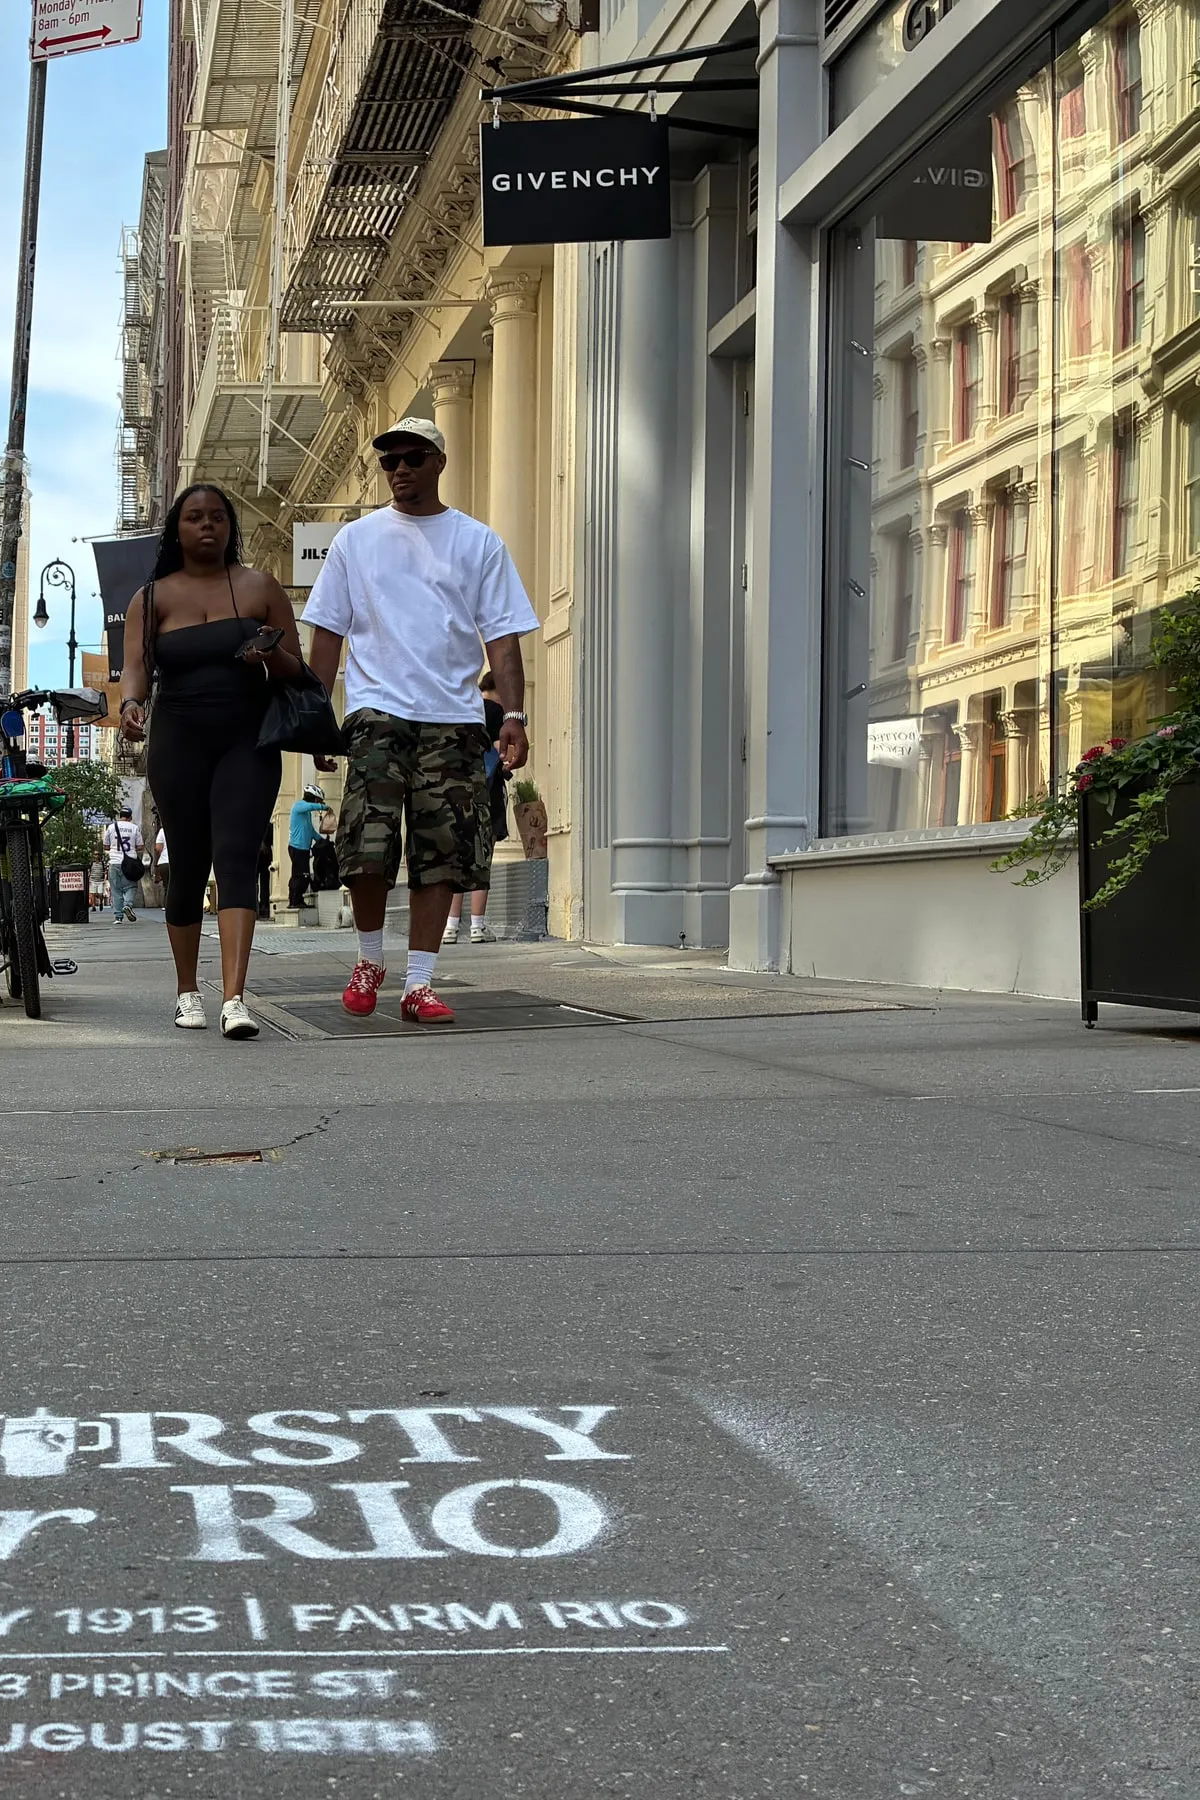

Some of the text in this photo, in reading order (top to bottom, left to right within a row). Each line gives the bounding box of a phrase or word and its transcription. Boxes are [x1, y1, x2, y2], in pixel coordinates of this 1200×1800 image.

[38, 18, 59, 31] 8am
[68, 12, 90, 27] 6pm
[39, 0, 76, 15] Monday
[492, 166, 660, 192] GIVENCHY
[169, 1478, 611, 1560] RIO
[54, 1604, 221, 1636] 1913
[291, 1601, 524, 1633] FARM
[541, 1600, 689, 1629] RIO
[50, 1669, 301, 1700] PRINCE
[247, 1718, 439, 1755] 15TH
